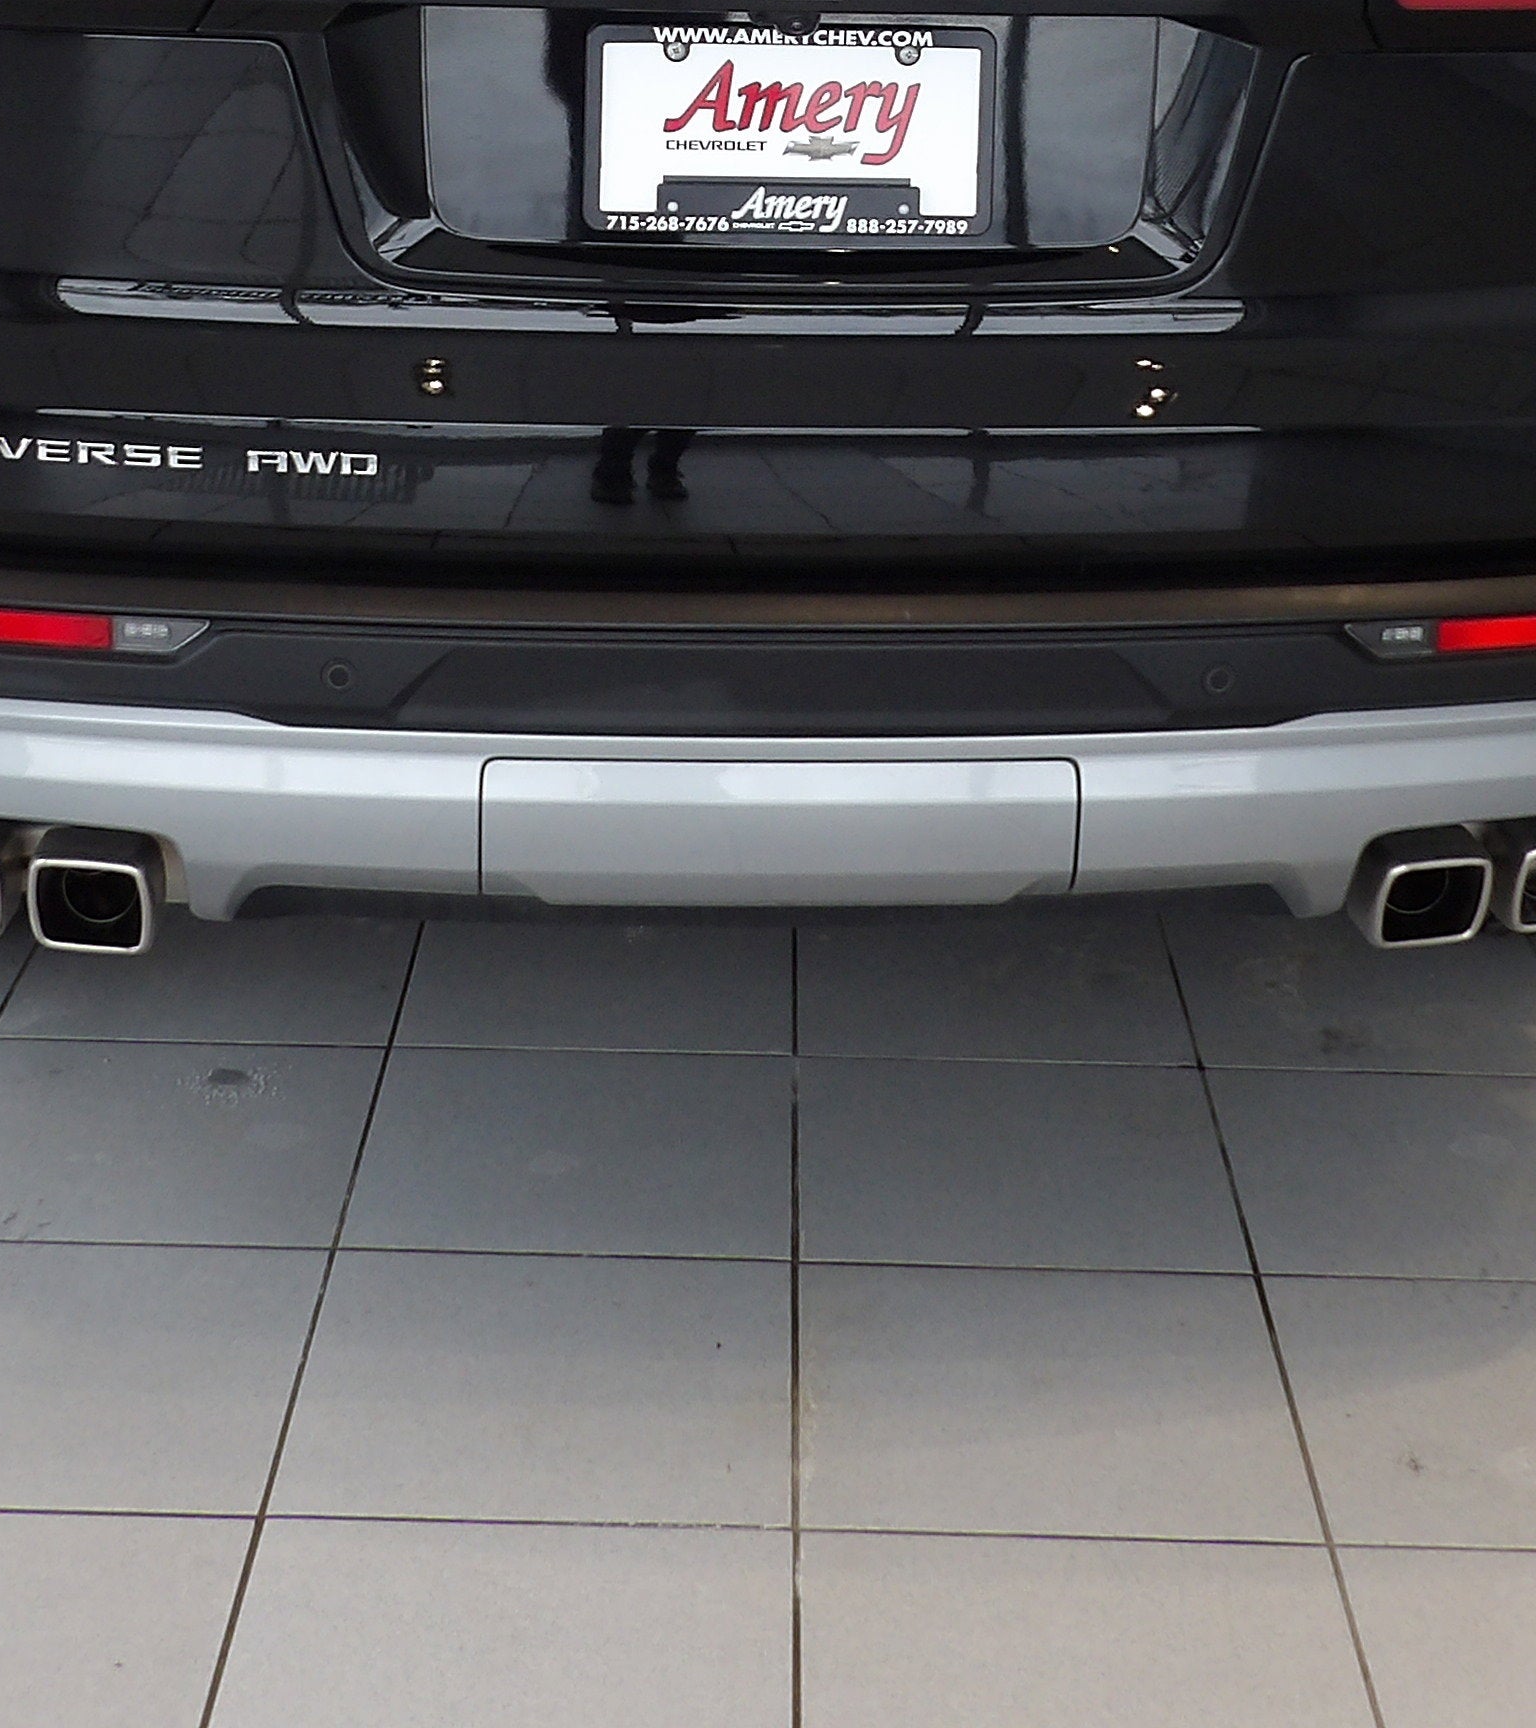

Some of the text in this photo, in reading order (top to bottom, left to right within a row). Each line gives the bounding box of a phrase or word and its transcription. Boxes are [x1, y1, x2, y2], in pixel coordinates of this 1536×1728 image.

[663, 59, 921, 165] Amery
[665, 139, 768, 152] CHEVROLET
[731, 185, 849, 232] Amery
[606, 215, 729, 232] 715-268-7676
[846, 218, 968, 235] 888-257-7989
[246, 450, 379, 476] AWD
